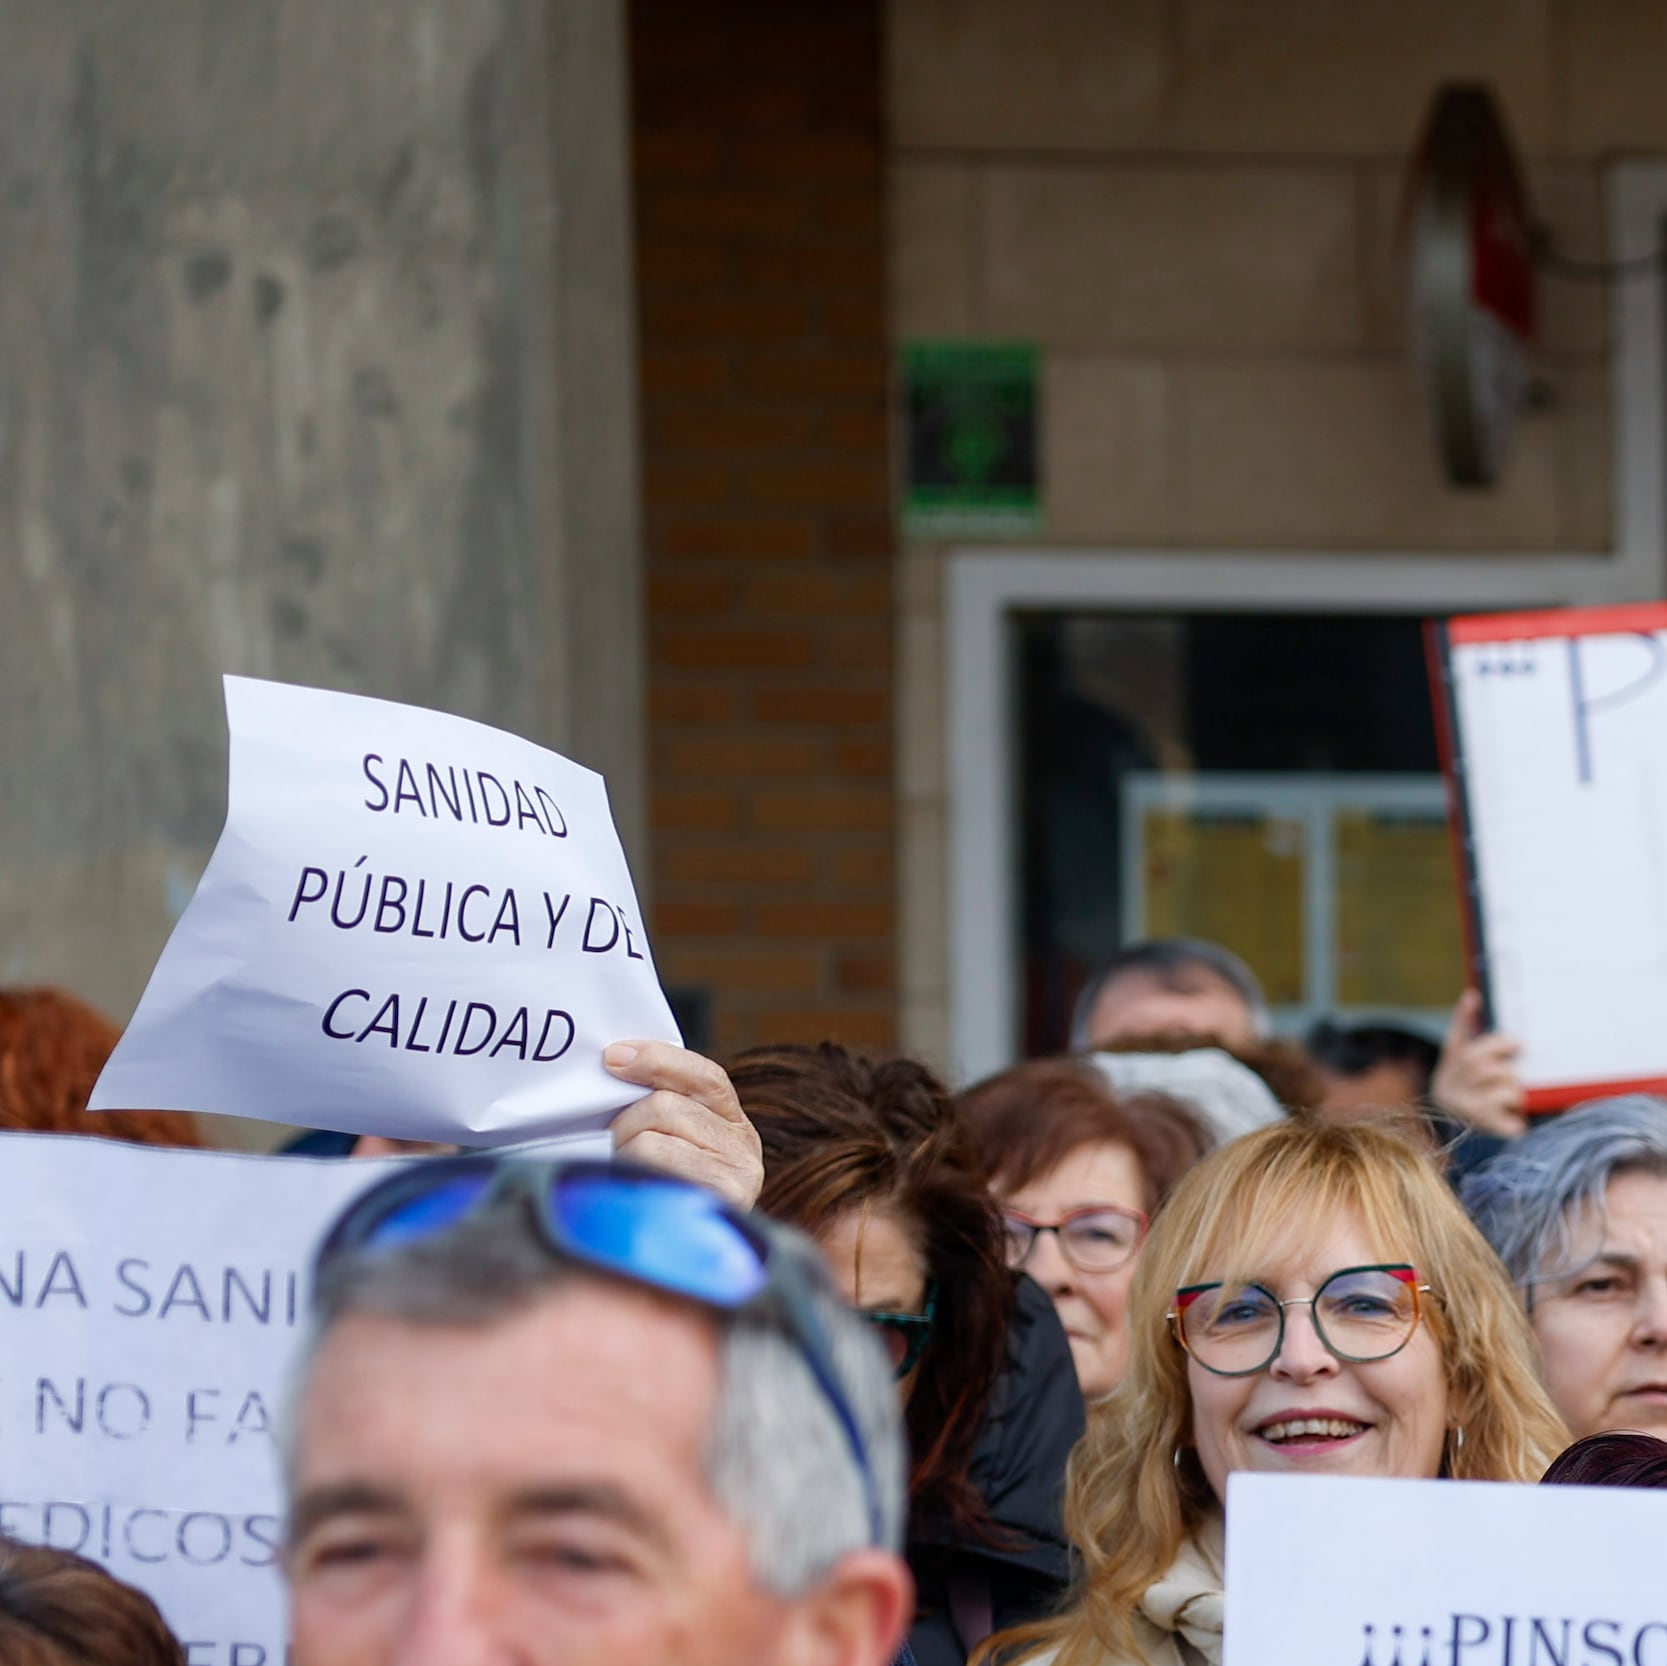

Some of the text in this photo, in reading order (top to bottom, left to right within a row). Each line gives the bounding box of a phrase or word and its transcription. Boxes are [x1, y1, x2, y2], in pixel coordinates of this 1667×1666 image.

[363, 753, 567, 839] SANIDAD
[288, 855, 644, 961] PÚBLICA Y DE
[321, 988, 576, 1063] CALIDAD
[35, 1376, 151, 1440] NO
